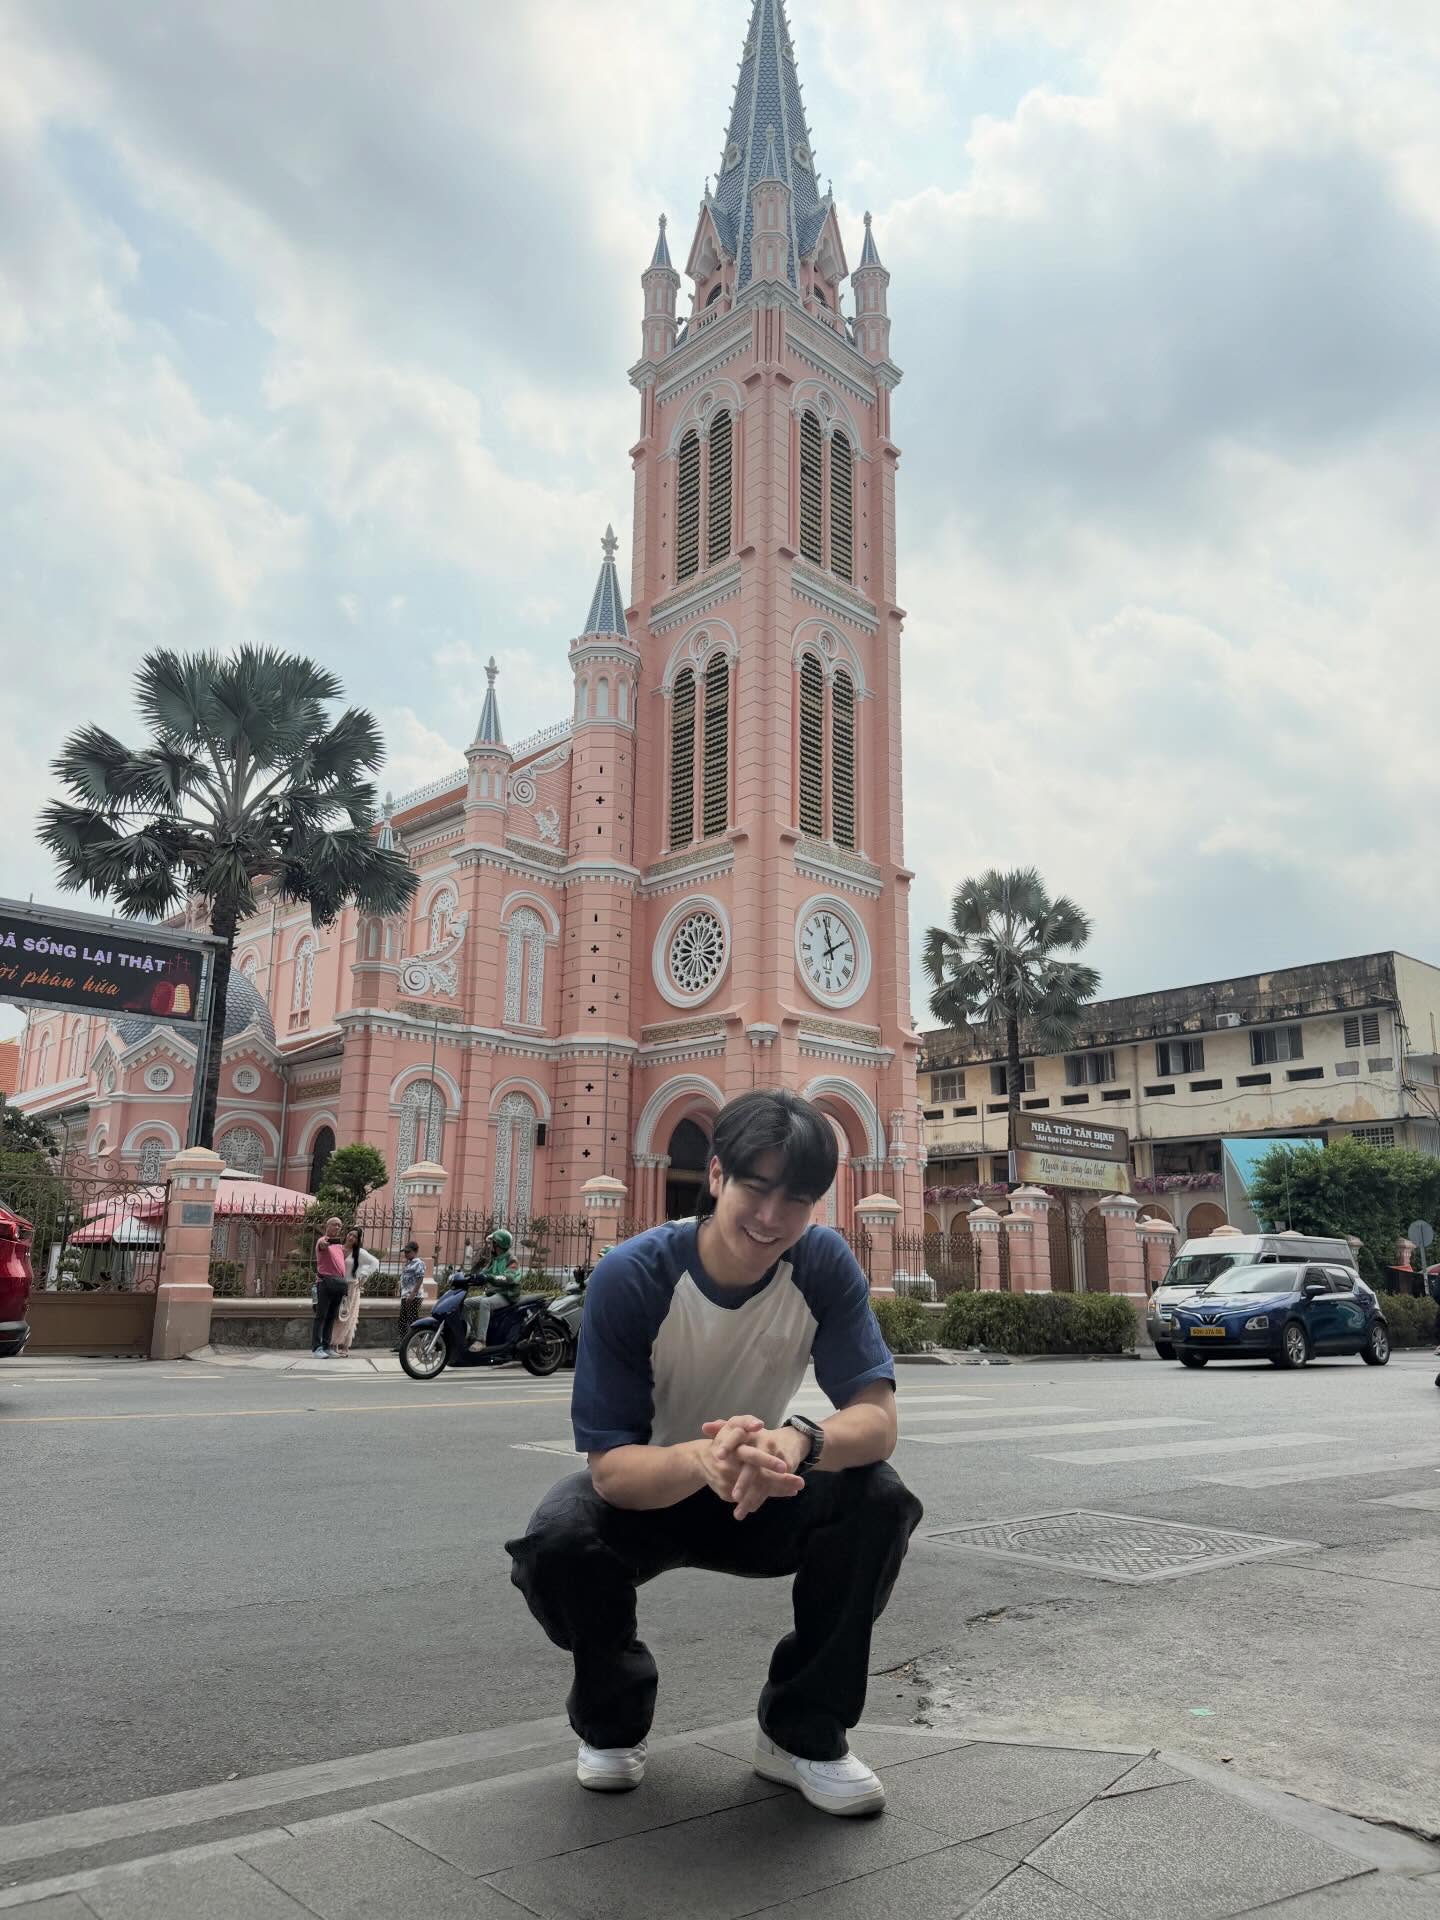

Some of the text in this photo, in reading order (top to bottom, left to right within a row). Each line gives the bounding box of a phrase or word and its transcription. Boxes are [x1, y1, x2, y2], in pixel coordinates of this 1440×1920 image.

[23, 936, 77, 959] SỐNG
[82, 947, 112, 966] LẠI
[118, 953, 165, 973] THẬT
[20, 968, 76, 988] phán
[1032, 1122, 1115, 1143] NHÀ THỜ TÂN ĐỊNH
[1062, 1138, 1089, 1148] CATHOLIC
[1090, 1142, 1112, 1151] CHURCH
